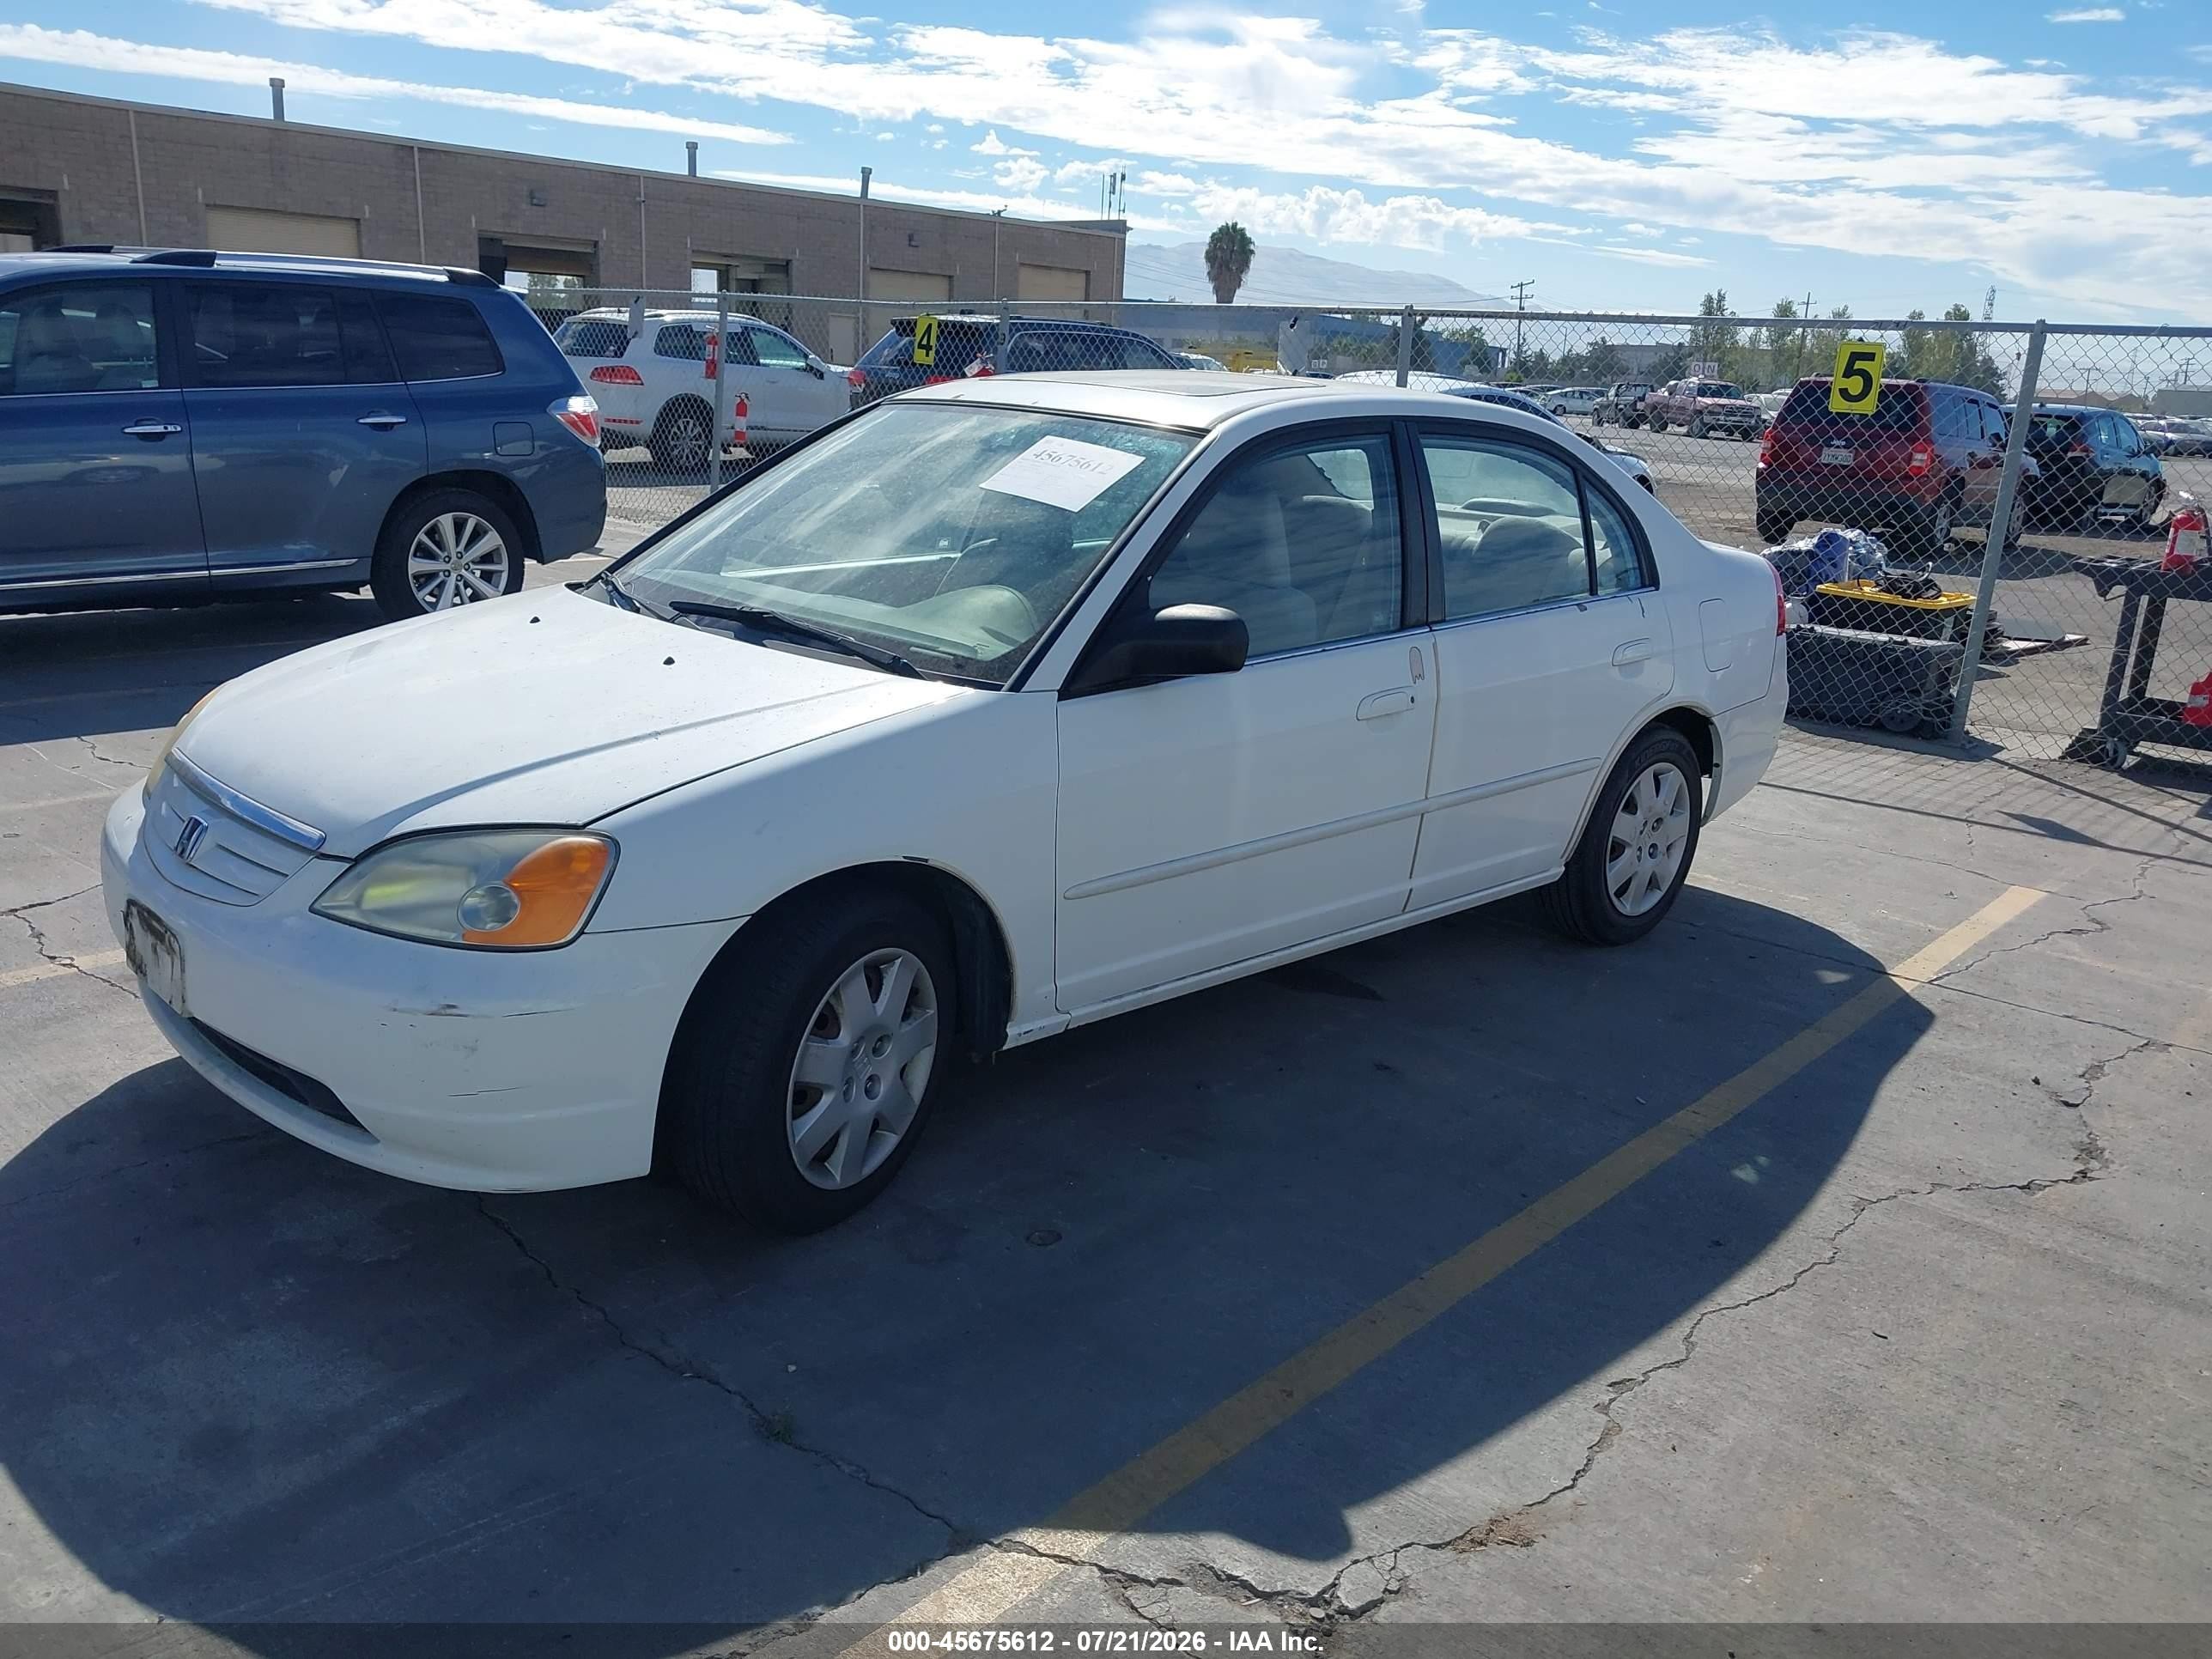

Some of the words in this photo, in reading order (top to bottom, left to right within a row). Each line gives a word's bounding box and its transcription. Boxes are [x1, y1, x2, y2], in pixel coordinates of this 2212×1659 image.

[917, 323, 933, 358] 4
[1838, 351, 1876, 403] 5
[1033, 449, 1114, 474] 45675612
